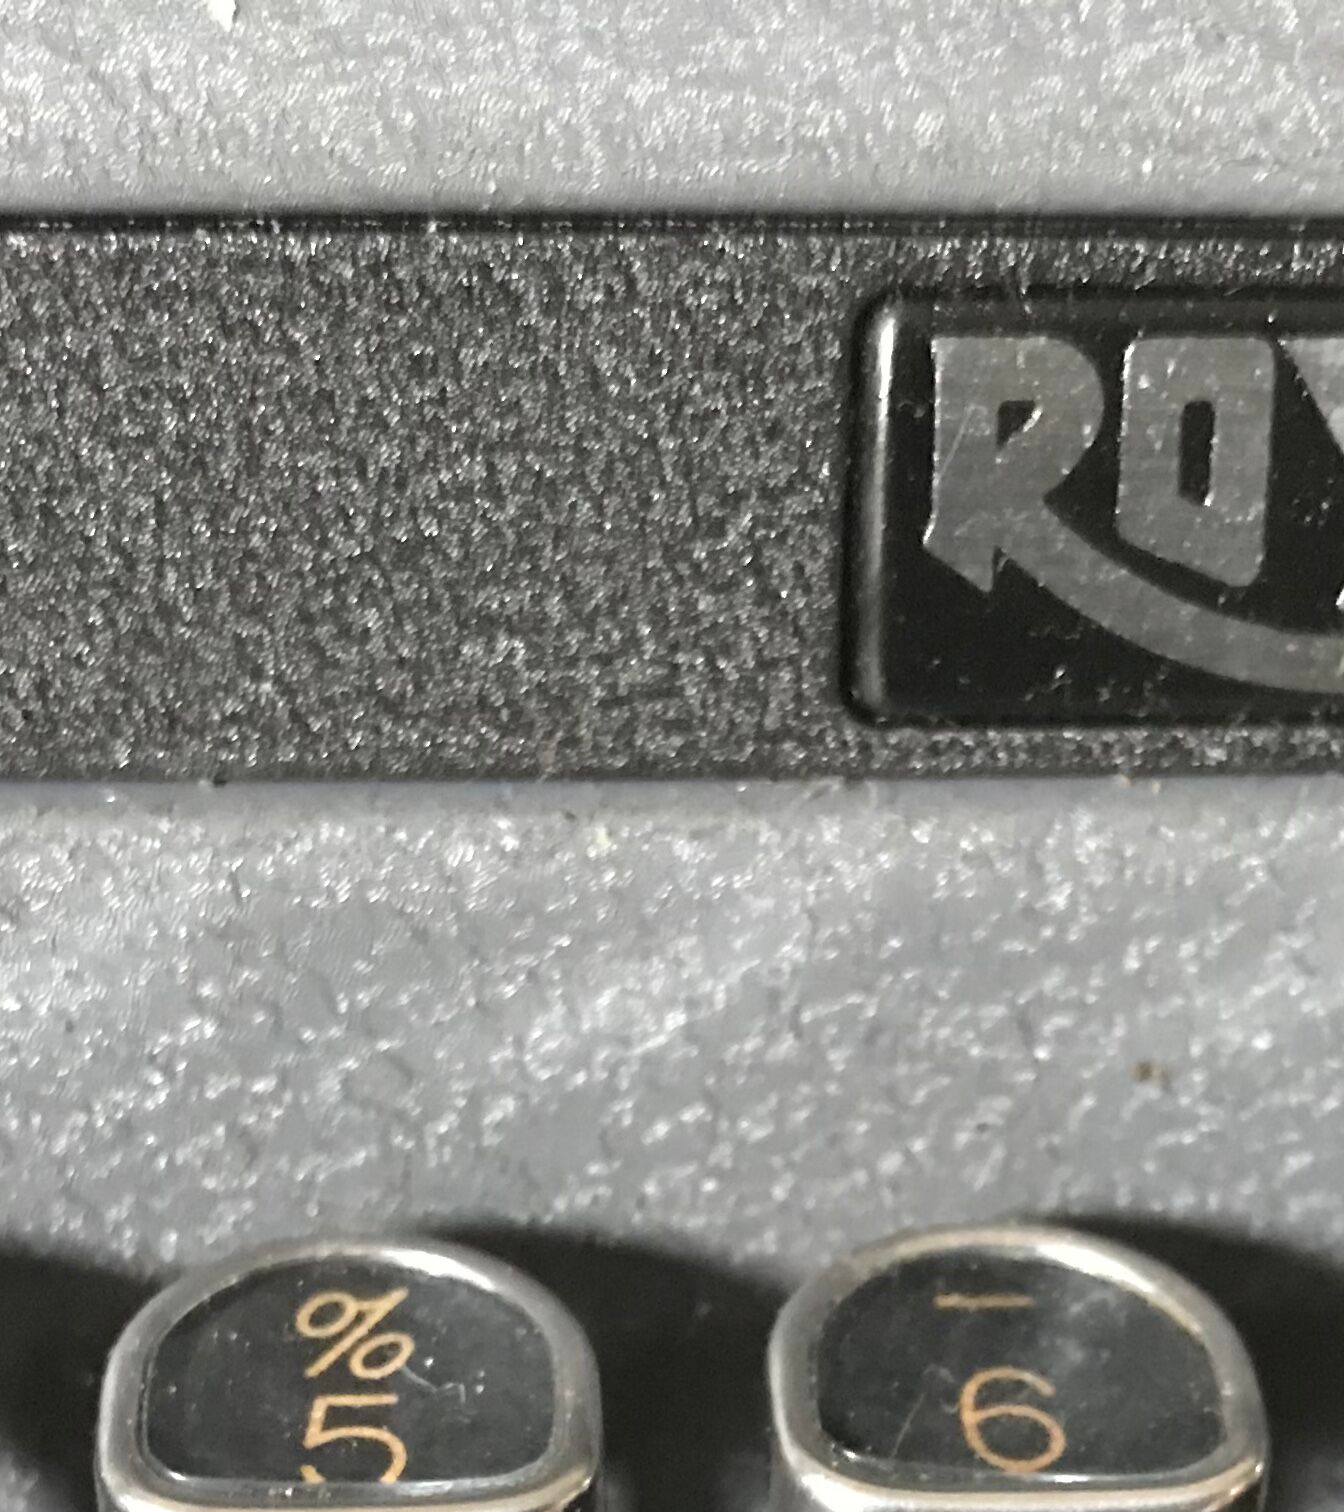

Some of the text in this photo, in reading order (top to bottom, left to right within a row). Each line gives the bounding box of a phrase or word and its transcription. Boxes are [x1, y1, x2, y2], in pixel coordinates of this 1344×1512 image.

[295, 1289, 413, 1380] %
[299, 1392, 407, 1484] 5
[958, 1367, 1066, 1473] 6
